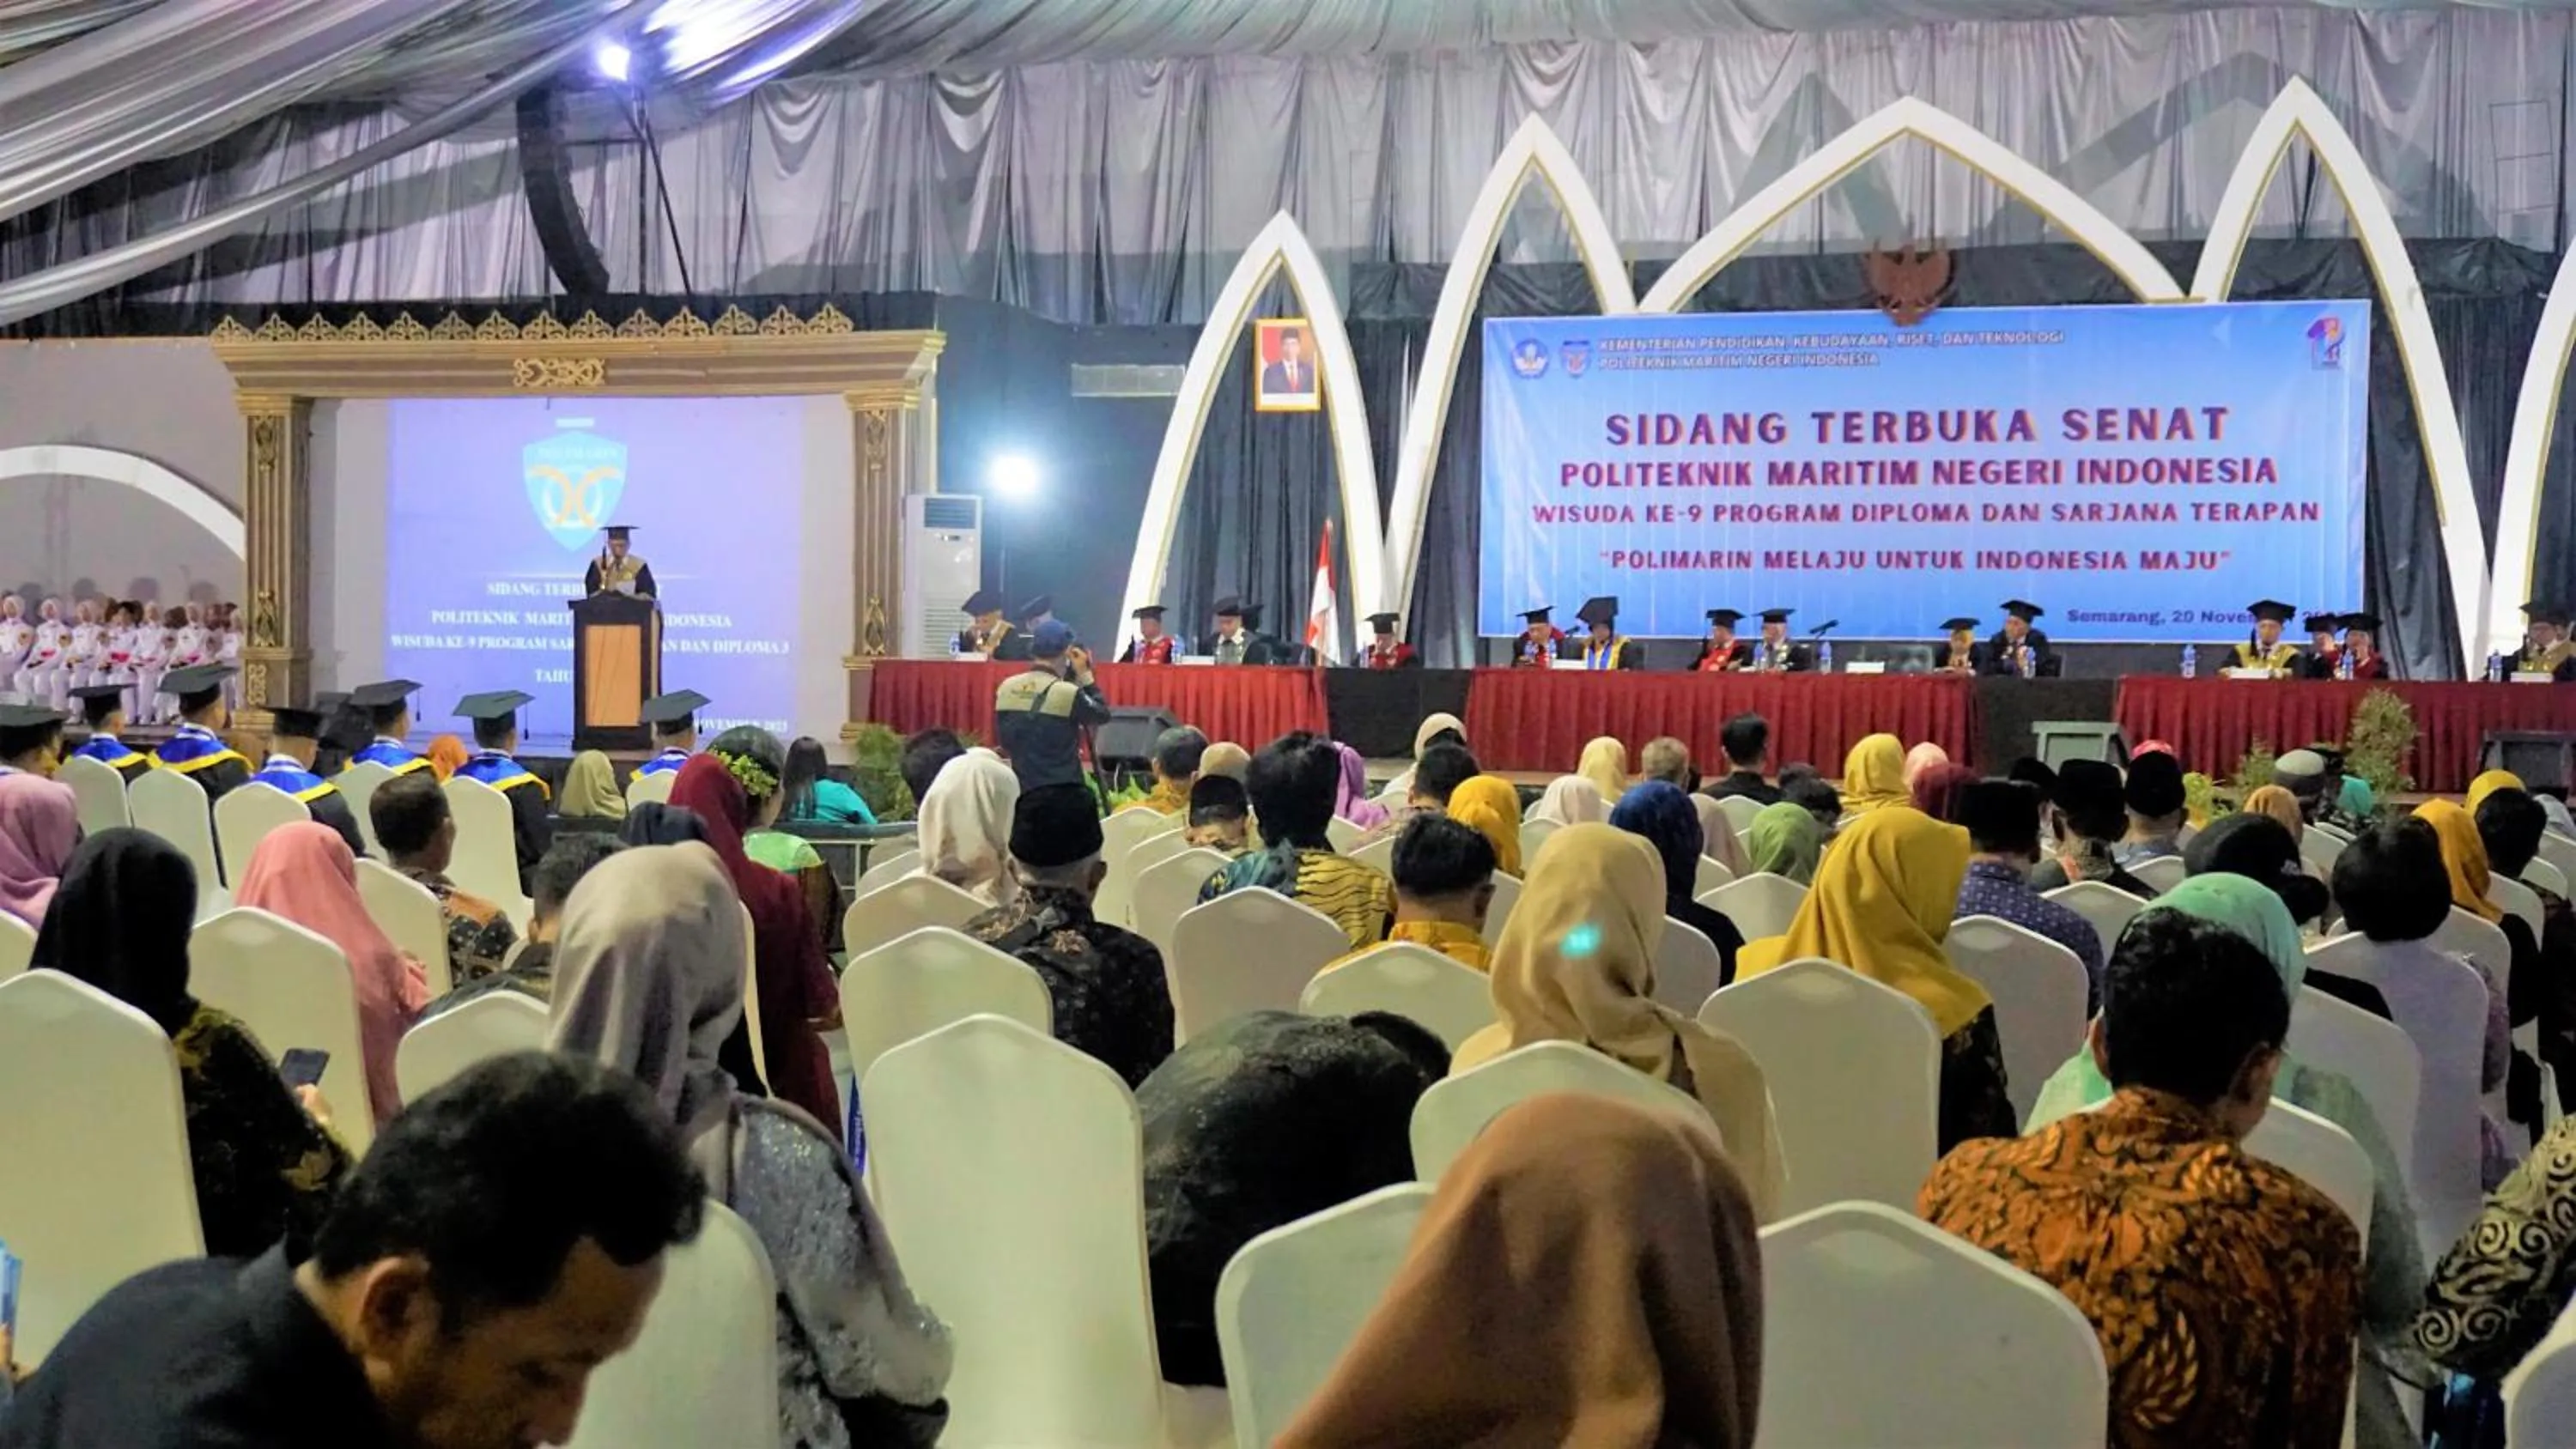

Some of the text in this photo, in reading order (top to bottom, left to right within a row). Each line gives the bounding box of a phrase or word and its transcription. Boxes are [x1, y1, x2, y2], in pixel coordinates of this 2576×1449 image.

[1598, 337, 1697, 352] KEMENTERIAN
[1943, 331, 1974, 345] DAN
[1978, 330, 2064, 345] TEKNOLOGI
[1683, 355, 1743, 368] MARITIM
[1799, 353, 1880, 367] INDONESIA
[1605, 407, 2229, 445] SIDANG TERBUKA SENAT
[1559, 458, 2277, 487] POLITEKNIK MARITIM NEGERI INDONESIA
[1532, 502, 2320, 523] WISUDA KE-9 PROGRAM DIPLOMA DAN SARJANA TERAPAN
[1765, 550, 1866, 568] MELAJU
[1876, 550, 1965, 569] UNTUK
[1976, 550, 2128, 569] INDONESIA
[544, 582, 586, 596] TERB
[430, 610, 732, 627] POLITEKNIK MARIT DONESIA
[2067, 609, 2166, 626] Semarang,
[2201, 610, 2253, 623] Nove
[535, 669, 573, 683] TAHU
